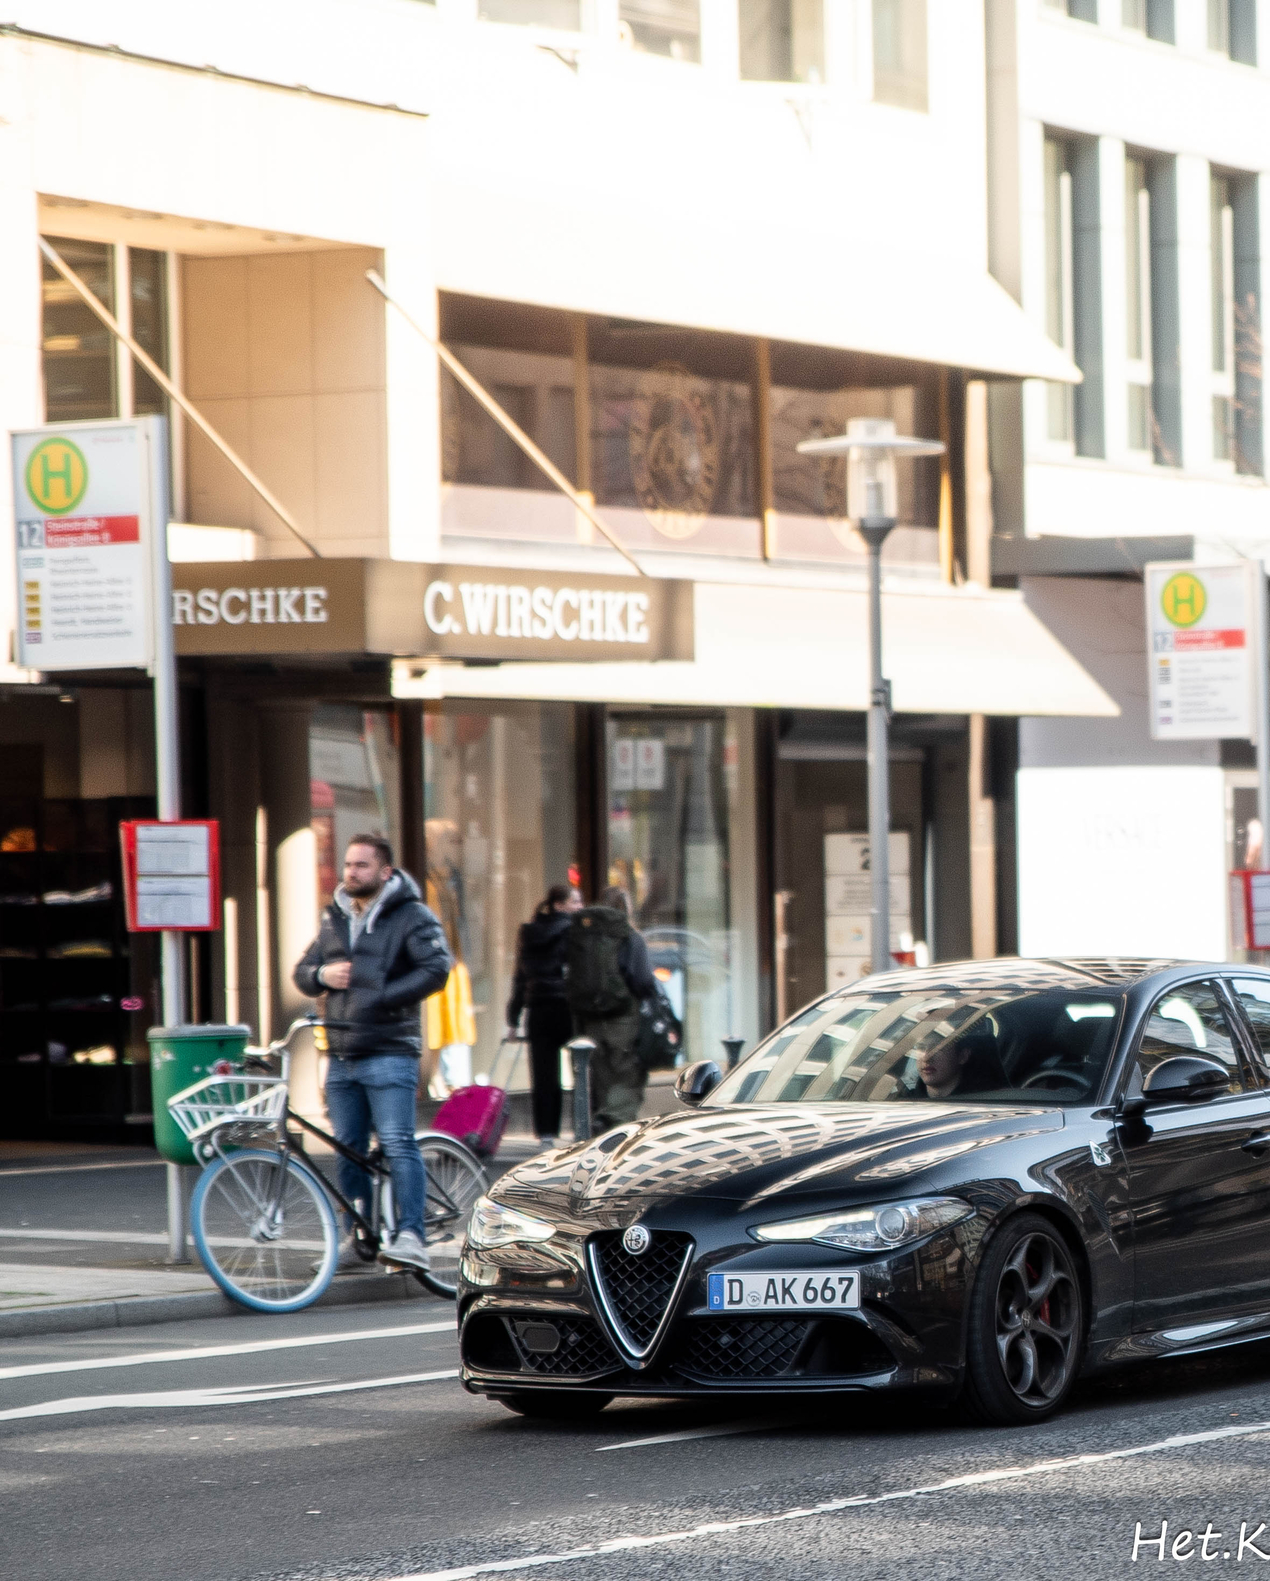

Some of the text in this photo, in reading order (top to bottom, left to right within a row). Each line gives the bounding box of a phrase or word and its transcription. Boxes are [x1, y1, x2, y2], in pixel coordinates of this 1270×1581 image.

[41, 453, 72, 499] H
[19, 523, 42, 546] 12
[424, 580, 650, 644] C.WIRSCHKE
[1173, 583, 1195, 616] H
[727, 1278, 744, 1306] D
[802, 1276, 854, 1304] 667
